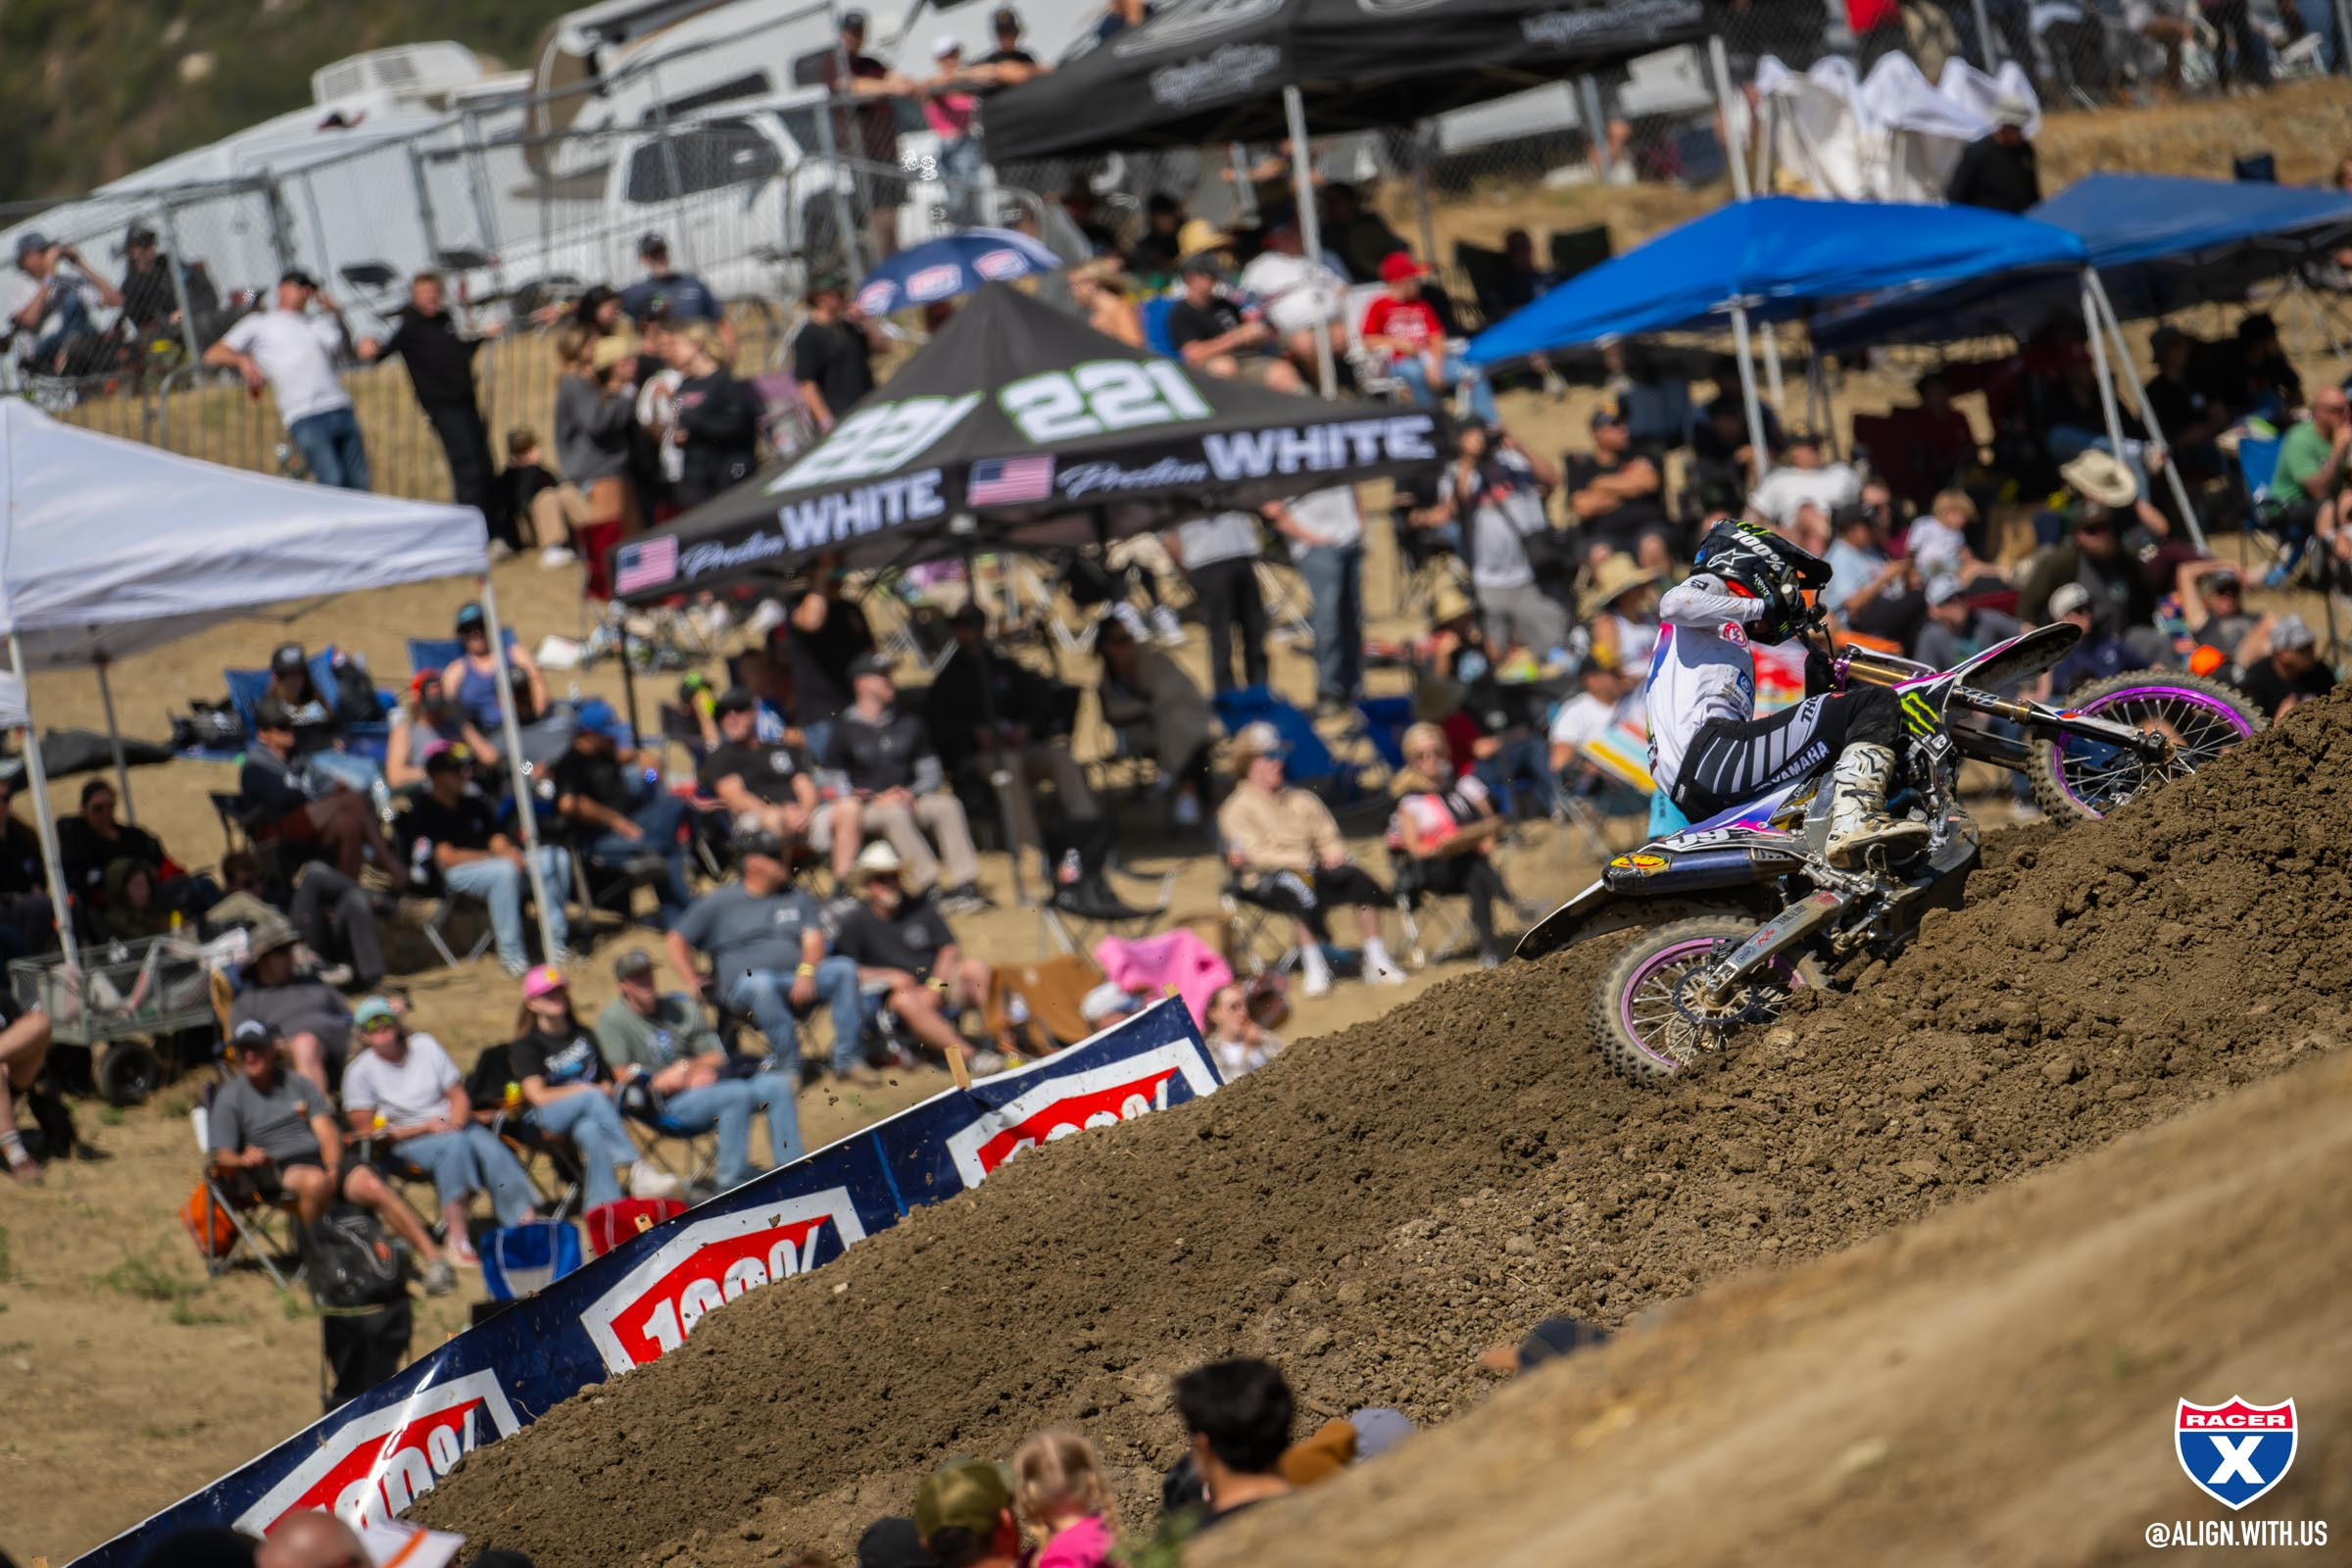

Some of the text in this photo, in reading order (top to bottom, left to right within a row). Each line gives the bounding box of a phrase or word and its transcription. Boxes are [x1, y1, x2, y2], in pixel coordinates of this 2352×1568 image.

[1000, 360, 1213, 444] 221
[1201, 415, 1436, 481] WHITE
[778, 467, 946, 551] WHITE
[1731, 529, 1785, 571] 100%
[1772, 738, 1831, 785] YAMAHA
